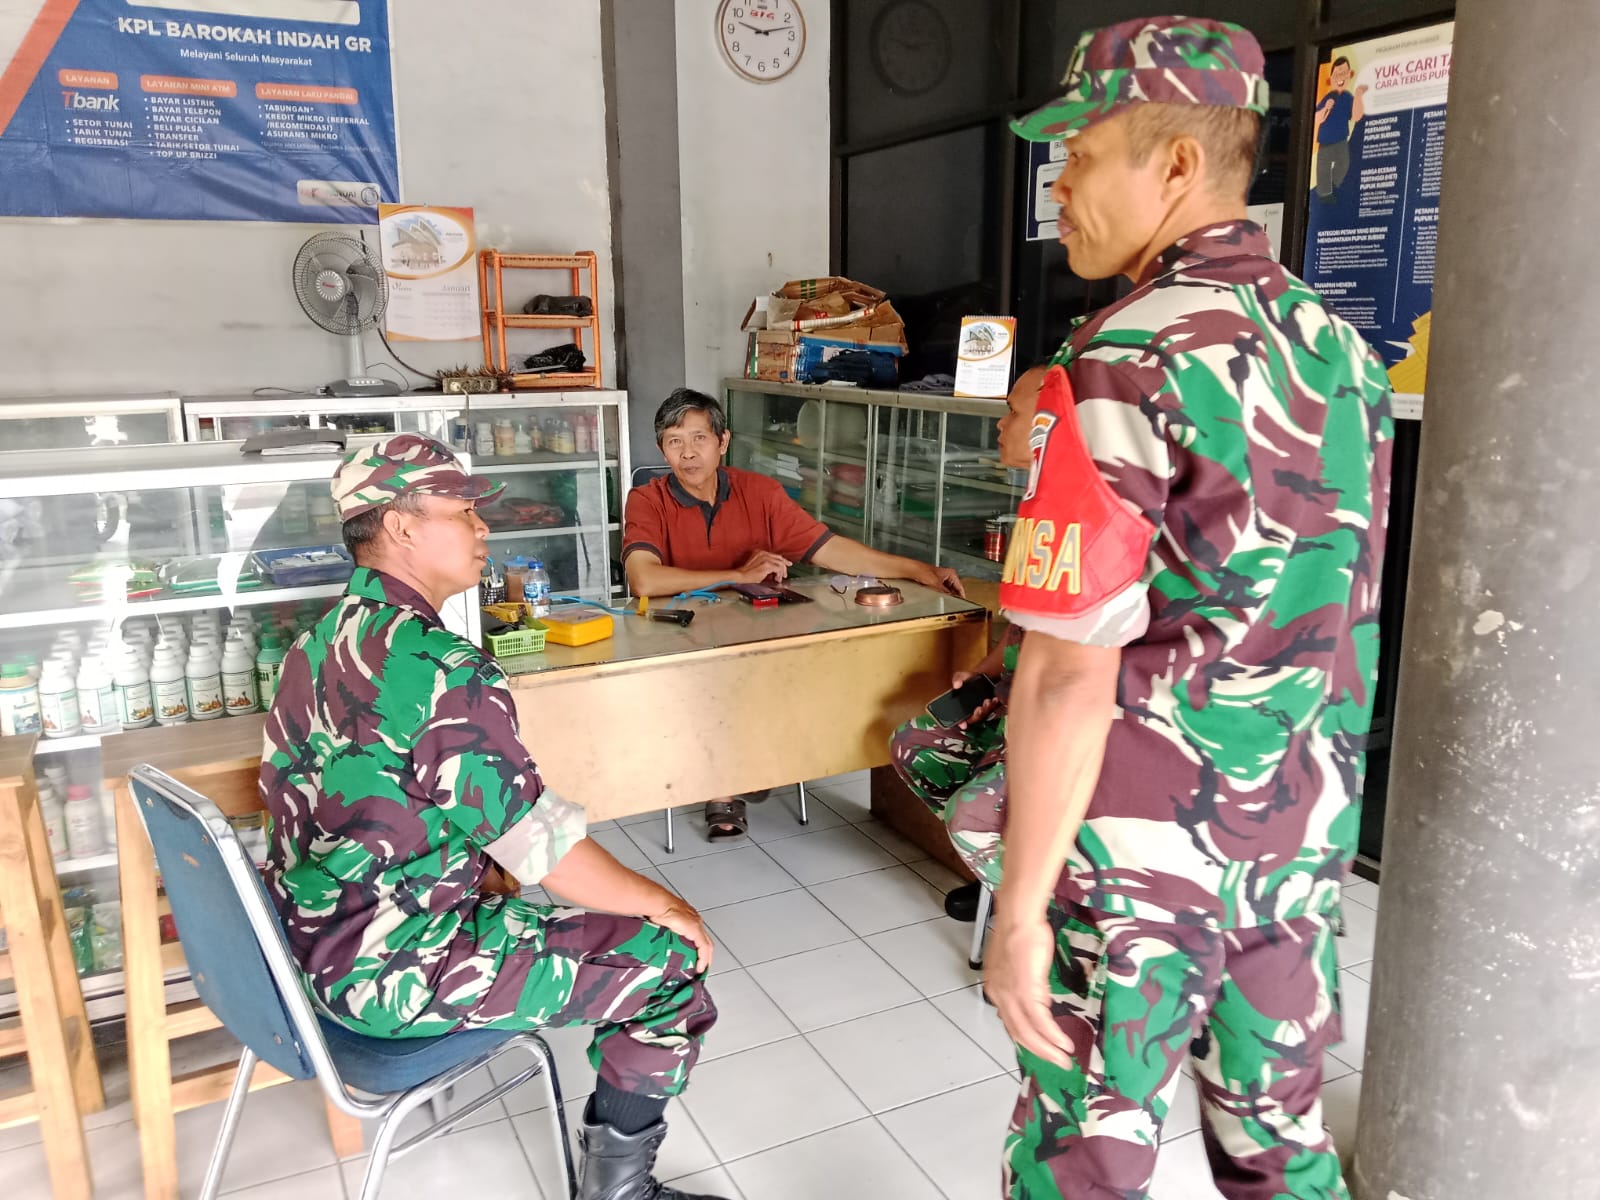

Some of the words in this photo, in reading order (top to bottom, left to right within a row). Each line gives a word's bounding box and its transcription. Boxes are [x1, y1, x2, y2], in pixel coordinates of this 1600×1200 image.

[733, 8, 744, 18] 10
[784, 12, 791, 23] 2
[728, 24, 735, 34] 9
[118, 16, 162, 37] KPL
[166, 20, 272, 45] BAROKAH
[277, 30, 340, 50] INDAH
[345, 36, 372, 53] GR
[788, 31, 795, 41] 3
[732, 41, 740, 52] 8
[784, 48, 790, 56] 4
[180, 48, 222, 62] Melayani
[225, 51, 259, 63] Seluruh
[262, 55, 312, 67] Masyarakat
[745, 56, 751, 66] 7
[758, 62, 766, 72] 6
[773, 58, 780, 68] 5
[1375, 64, 1403, 79] YUK,
[1405, 56, 1437, 73] CARI
[66, 75, 110, 85] LAYANAN
[1375, 78, 1398, 90] CARA
[1400, 72, 1427, 85] TEBUS
[261, 88, 300, 97] LAYANAN
[151, 97, 180, 105] BAYAR
[183, 98, 215, 107] LISTRIK
[184, 107, 221, 116] TELEPON
[73, 119, 102, 127] SETOR
[104, 121, 133, 129] TUNAI
[184, 116, 219, 124] CICILAN
[327, 116, 369, 125] (REFERRAL
[175, 125, 203, 133] PULSA
[267, 121, 333, 132] /REKOMENDASI)
[155, 133, 199, 141] TRANSFER
[267, 130, 309, 139] ASURANSI
[311, 132, 338, 140] MIKRO
[75, 137, 128, 146] REGISTRASI
[156, 142, 212, 151] TARIK/SETOR
